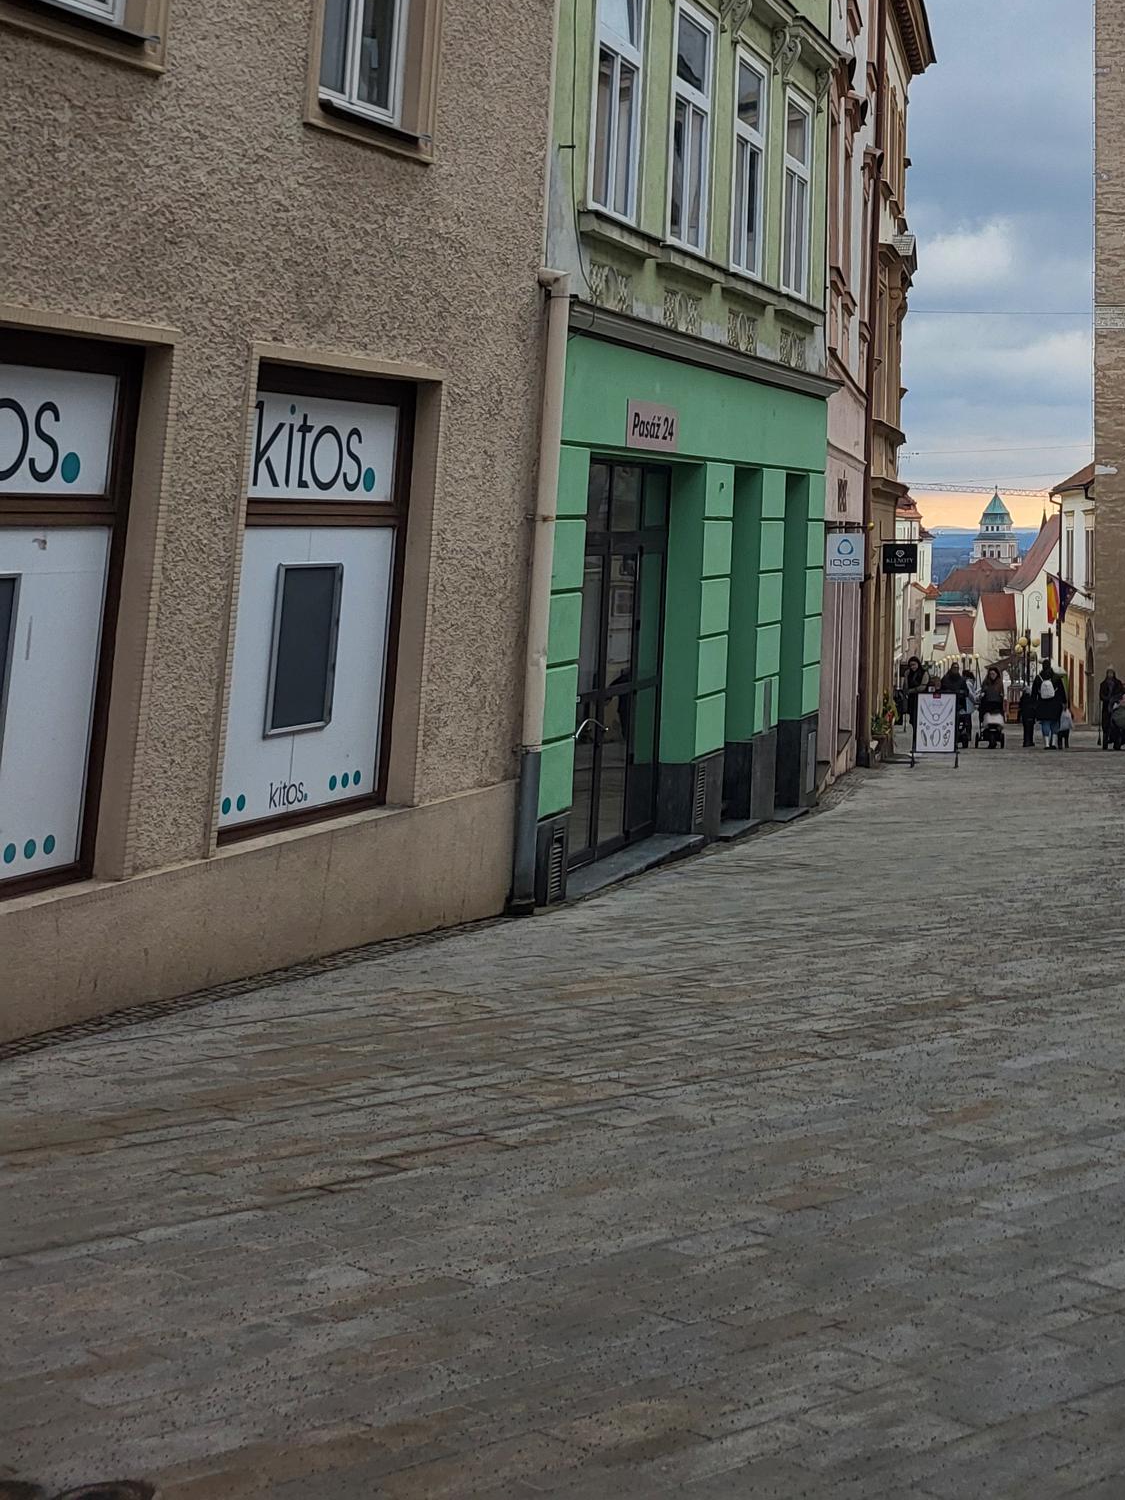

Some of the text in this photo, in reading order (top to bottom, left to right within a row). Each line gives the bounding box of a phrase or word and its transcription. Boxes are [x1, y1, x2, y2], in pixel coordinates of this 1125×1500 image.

[632, 412, 675, 441] Pasáž 24
[252, 401, 375, 492] kitos.
[830, 558, 860, 568] IQOS
[269, 780, 308, 809] kitos.
